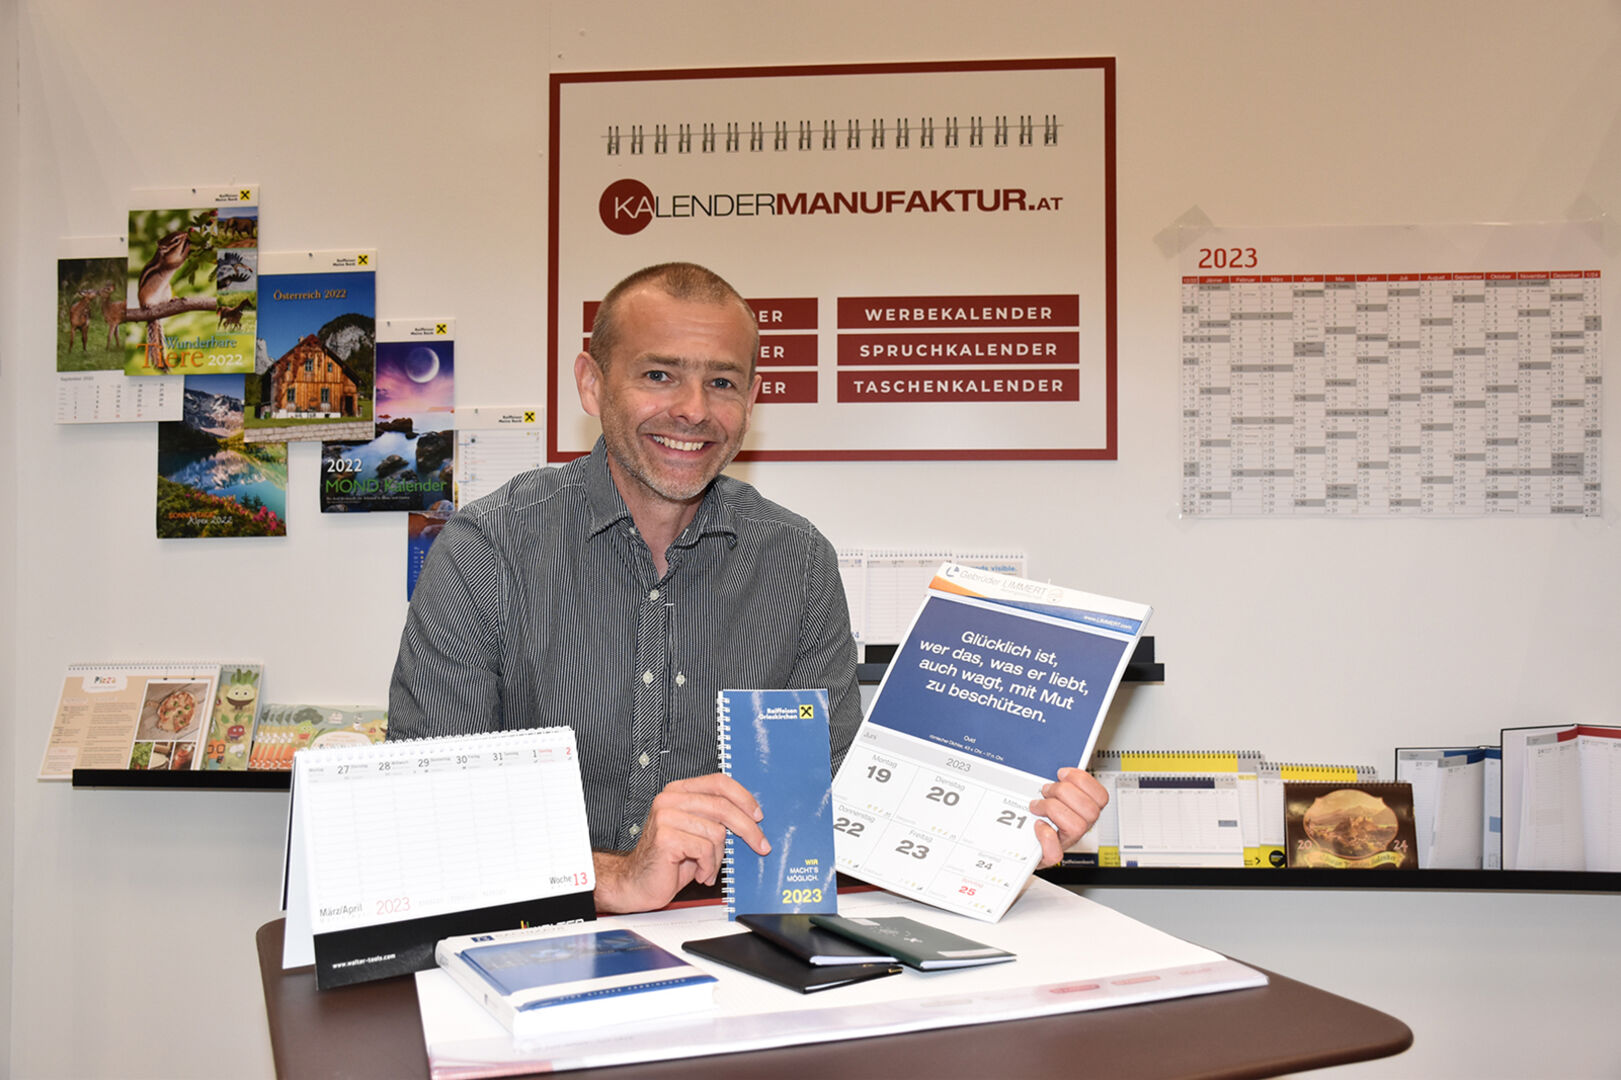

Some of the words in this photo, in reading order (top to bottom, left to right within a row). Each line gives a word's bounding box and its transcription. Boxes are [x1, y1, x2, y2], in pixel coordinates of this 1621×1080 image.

[613, 187, 1063, 219] KALENDERMANUFAKTUR.AT
[1198, 247, 1258, 269] 2023
[273, 288, 321, 301] Österreich
[324, 288, 347, 299] 2022
[865, 306, 1053, 321] WERBEKALENDER
[163, 335, 237, 350] Wunderbare
[860, 342, 1058, 358] SPRUCHKALENDER
[208, 354, 243, 366] 2022
[854, 377, 1064, 394] TASCHENKALENDER
[327, 458, 362, 472] 2022
[325, 479, 379, 493] MOND
[384, 478, 447, 492] Kalender
[961, 630, 1032, 660] Glücklich
[1034, 646, 1058, 667] ist,
[919, 640, 949, 657] wer
[951, 646, 984, 668] das,
[990, 658, 1024, 677] was
[1027, 668, 1047, 682] er
[1048, 669, 1089, 697] liebt,
[918, 657, 958, 681] auch
[961, 671, 1005, 694] wagt,
[1009, 681, 1037, 702] mit
[1039, 689, 1075, 712] Mut
[925, 678, 946, 694] zu
[947, 681, 1047, 725] beschützen.
[493, 752, 503, 761] 31
[532, 749, 537, 758] 1
[566, 746, 572, 755] 2
[378, 761, 392, 771] 28
[418, 758, 430, 767] 29
[456, 755, 468, 764] 30
[871, 754, 898, 769] Montag
[945, 757, 972, 773] 2023
[337, 765, 350, 775] 27
[866, 765, 892, 783] 19
[935, 775, 966, 792] Dienstag
[926, 785, 960, 807] 20
[838, 804, 875, 824] Donnerstag
[996, 809, 1027, 830] 21
[833, 817, 865, 838] 22
[909, 829, 933, 844] Freitag
[895, 839, 930, 860] 23
[1297, 839, 1313, 850] 20
[1393, 839, 1409, 853] 24
[975, 859, 993, 871] 24
[549, 874, 572, 886] Woche
[573, 872, 588, 886] 13
[782, 888, 822, 904] 2023
[957, 885, 976, 897] 25
[375, 896, 411, 916] 2023
